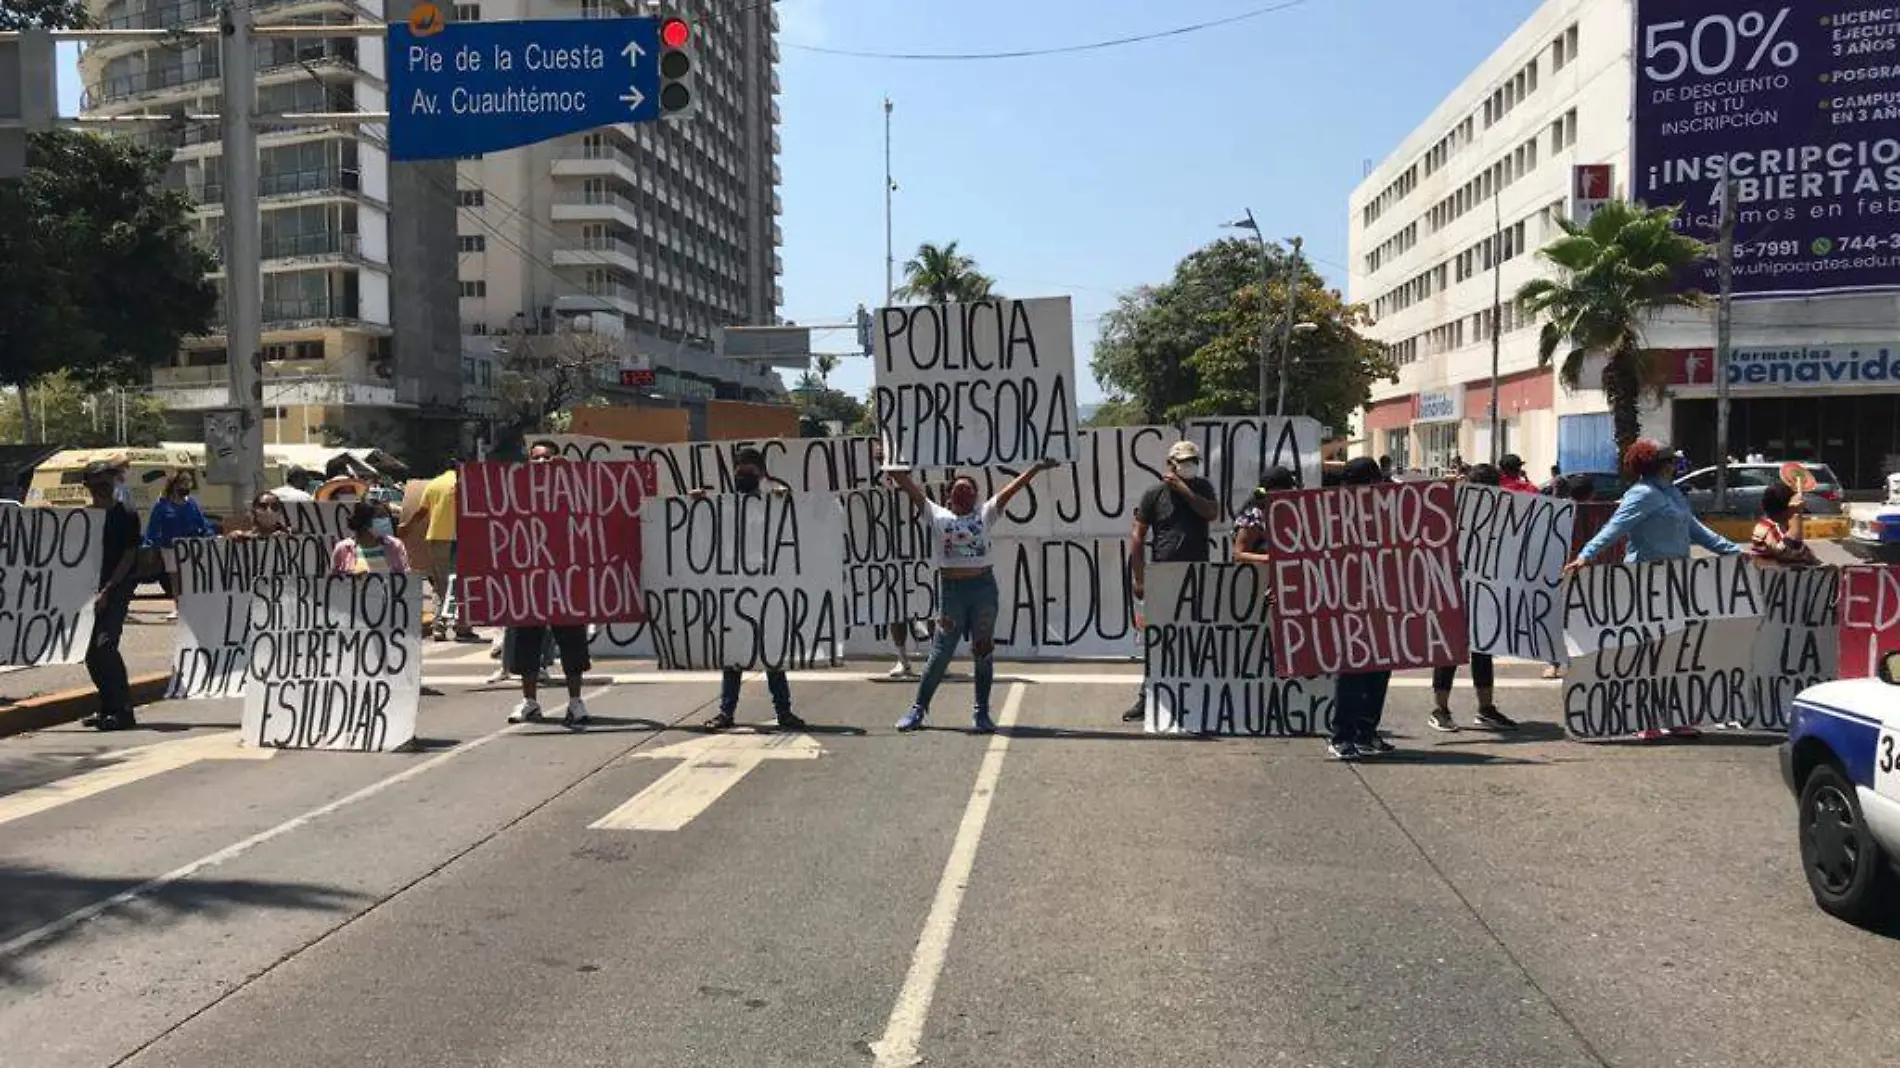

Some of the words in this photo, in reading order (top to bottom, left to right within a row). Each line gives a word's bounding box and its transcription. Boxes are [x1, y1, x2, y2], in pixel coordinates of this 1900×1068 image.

[409, 45, 443, 72] Pie
[455, 44, 482, 71] de
[494, 44, 512, 70] la
[525, 43, 604, 70] Cuesta
[1644, 6, 1799, 81] 50%
[1832, 43, 1842, 57] 3
[1846, 38, 1896, 55] AÑOS
[411, 88, 441, 115] Av.
[451, 85, 586, 115] Cuauhtémoc
[1653, 88, 1676, 104] DE
[1680, 74, 1789, 101] DESCUENTO
[1694, 100, 1717, 116] EN
[1722, 96, 1745, 112] TU
[1832, 110, 1854, 124] EN
[1858, 109, 1868, 122] 3
[1661, 107, 1779, 136] INSCRIPCIÓN
[1810, 203, 1842, 218] en
[882, 299, 1040, 373] POLICIA
[1731, 347, 1831, 361] farmacias
[877, 373, 1072, 467] REPRESORA
[460, 463, 647, 518] LUCHANDO
[1269, 482, 1454, 554] QUEREMOS
[489, 517, 556, 570] POR
[568, 514, 609, 566] MI
[666, 490, 801, 576] POLICIA
[16, 569, 53, 611] MI
[296, 571, 409, 630] RECTOR
[461, 554, 646, 627] EDUCACIÓN
[1174, 562, 1260, 623] ALTO
[1563, 557, 1759, 629] AUDIENCIA
[250, 628, 408, 685] QUEREMOS
[645, 586, 837, 671] REPRESORA
[1282, 608, 1454, 676] PUBLICA
[1595, 623, 1667, 680] CON
[1675, 619, 1709, 673] EL
[1780, 626, 1821, 676] LA
[259, 679, 391, 752] ESTUDIAR
[1153, 681, 1193, 733] DE
[1201, 681, 1236, 736] LA
[1565, 667, 1750, 738] GOBERNADOR
